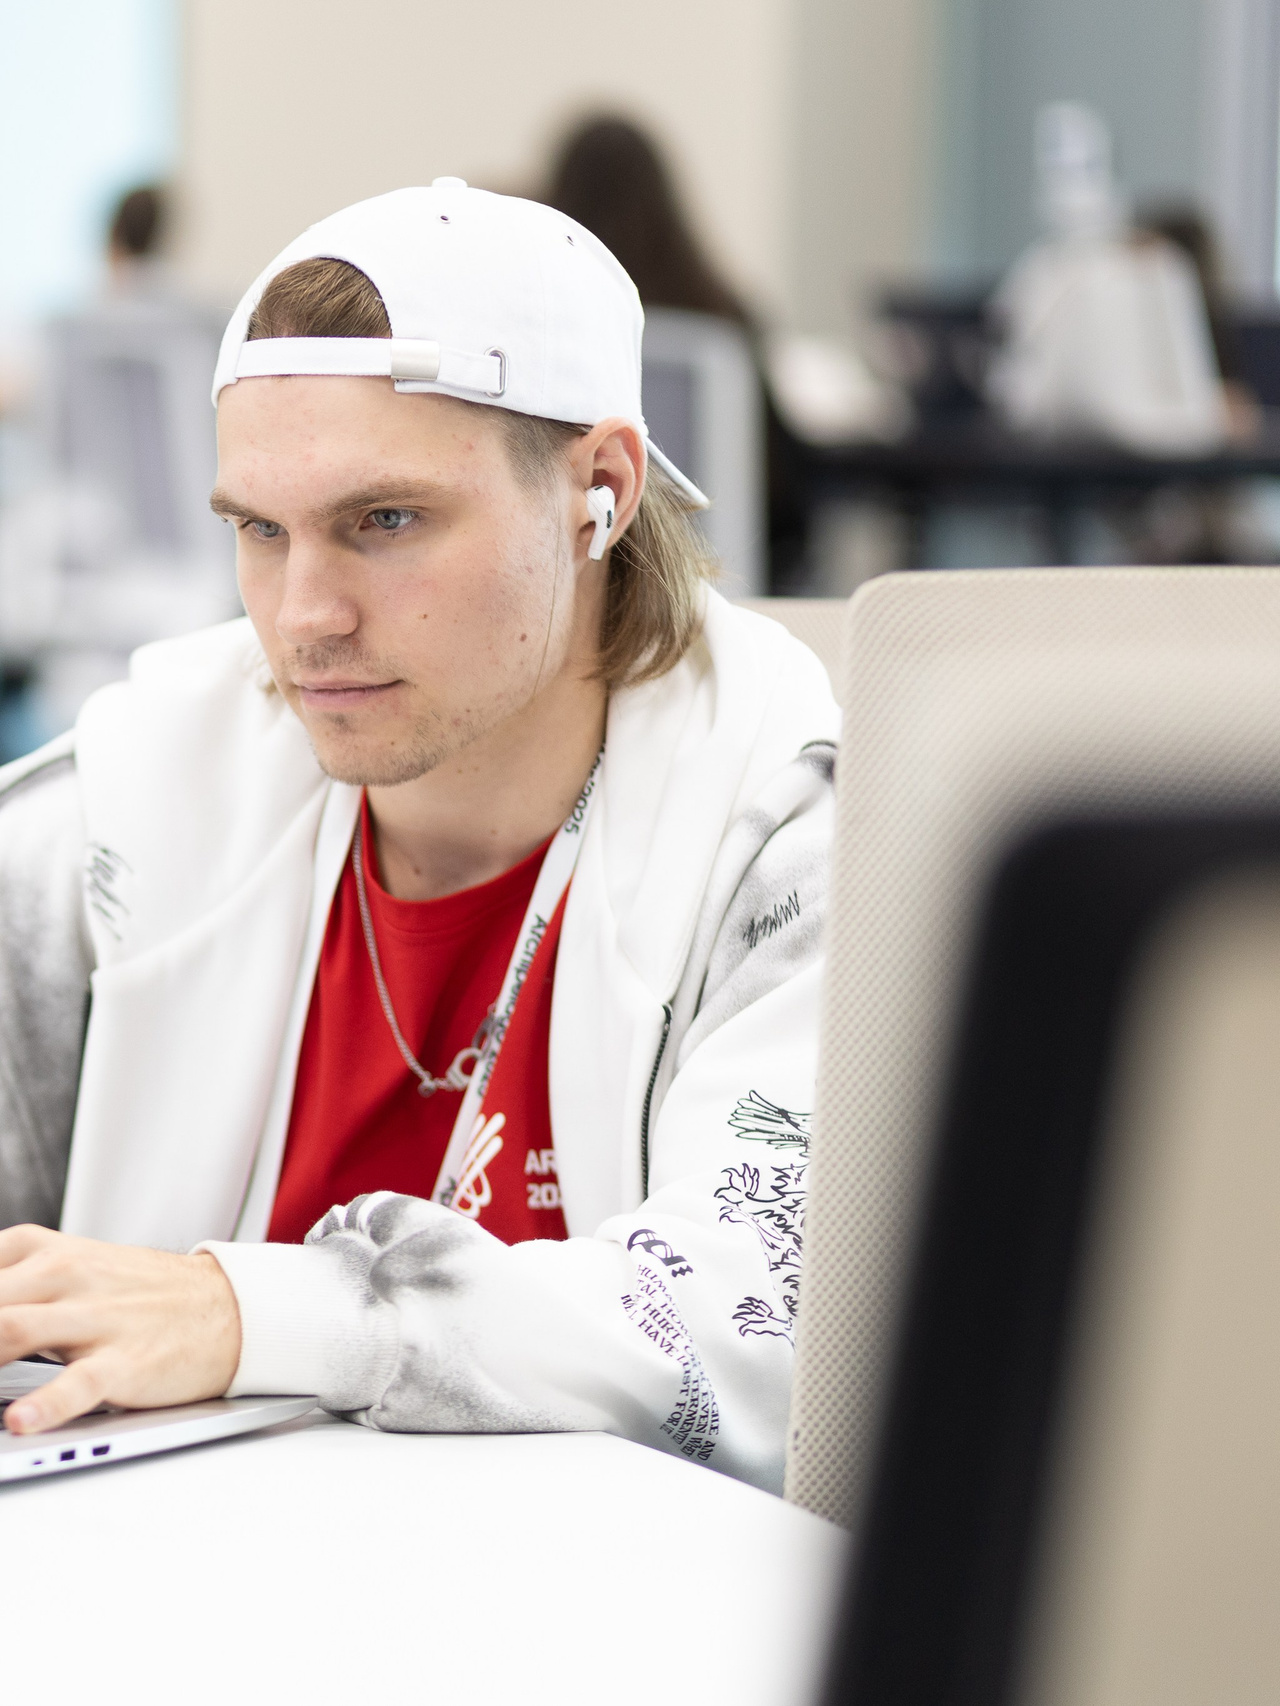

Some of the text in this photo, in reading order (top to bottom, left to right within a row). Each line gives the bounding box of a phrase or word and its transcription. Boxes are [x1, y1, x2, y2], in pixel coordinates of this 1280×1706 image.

[638, 1319, 680, 1356] HAVE
[643, 1303, 683, 1340] HURT
[694, 1391, 710, 1435] EVEN
[697, 1440, 716, 1461] AND
